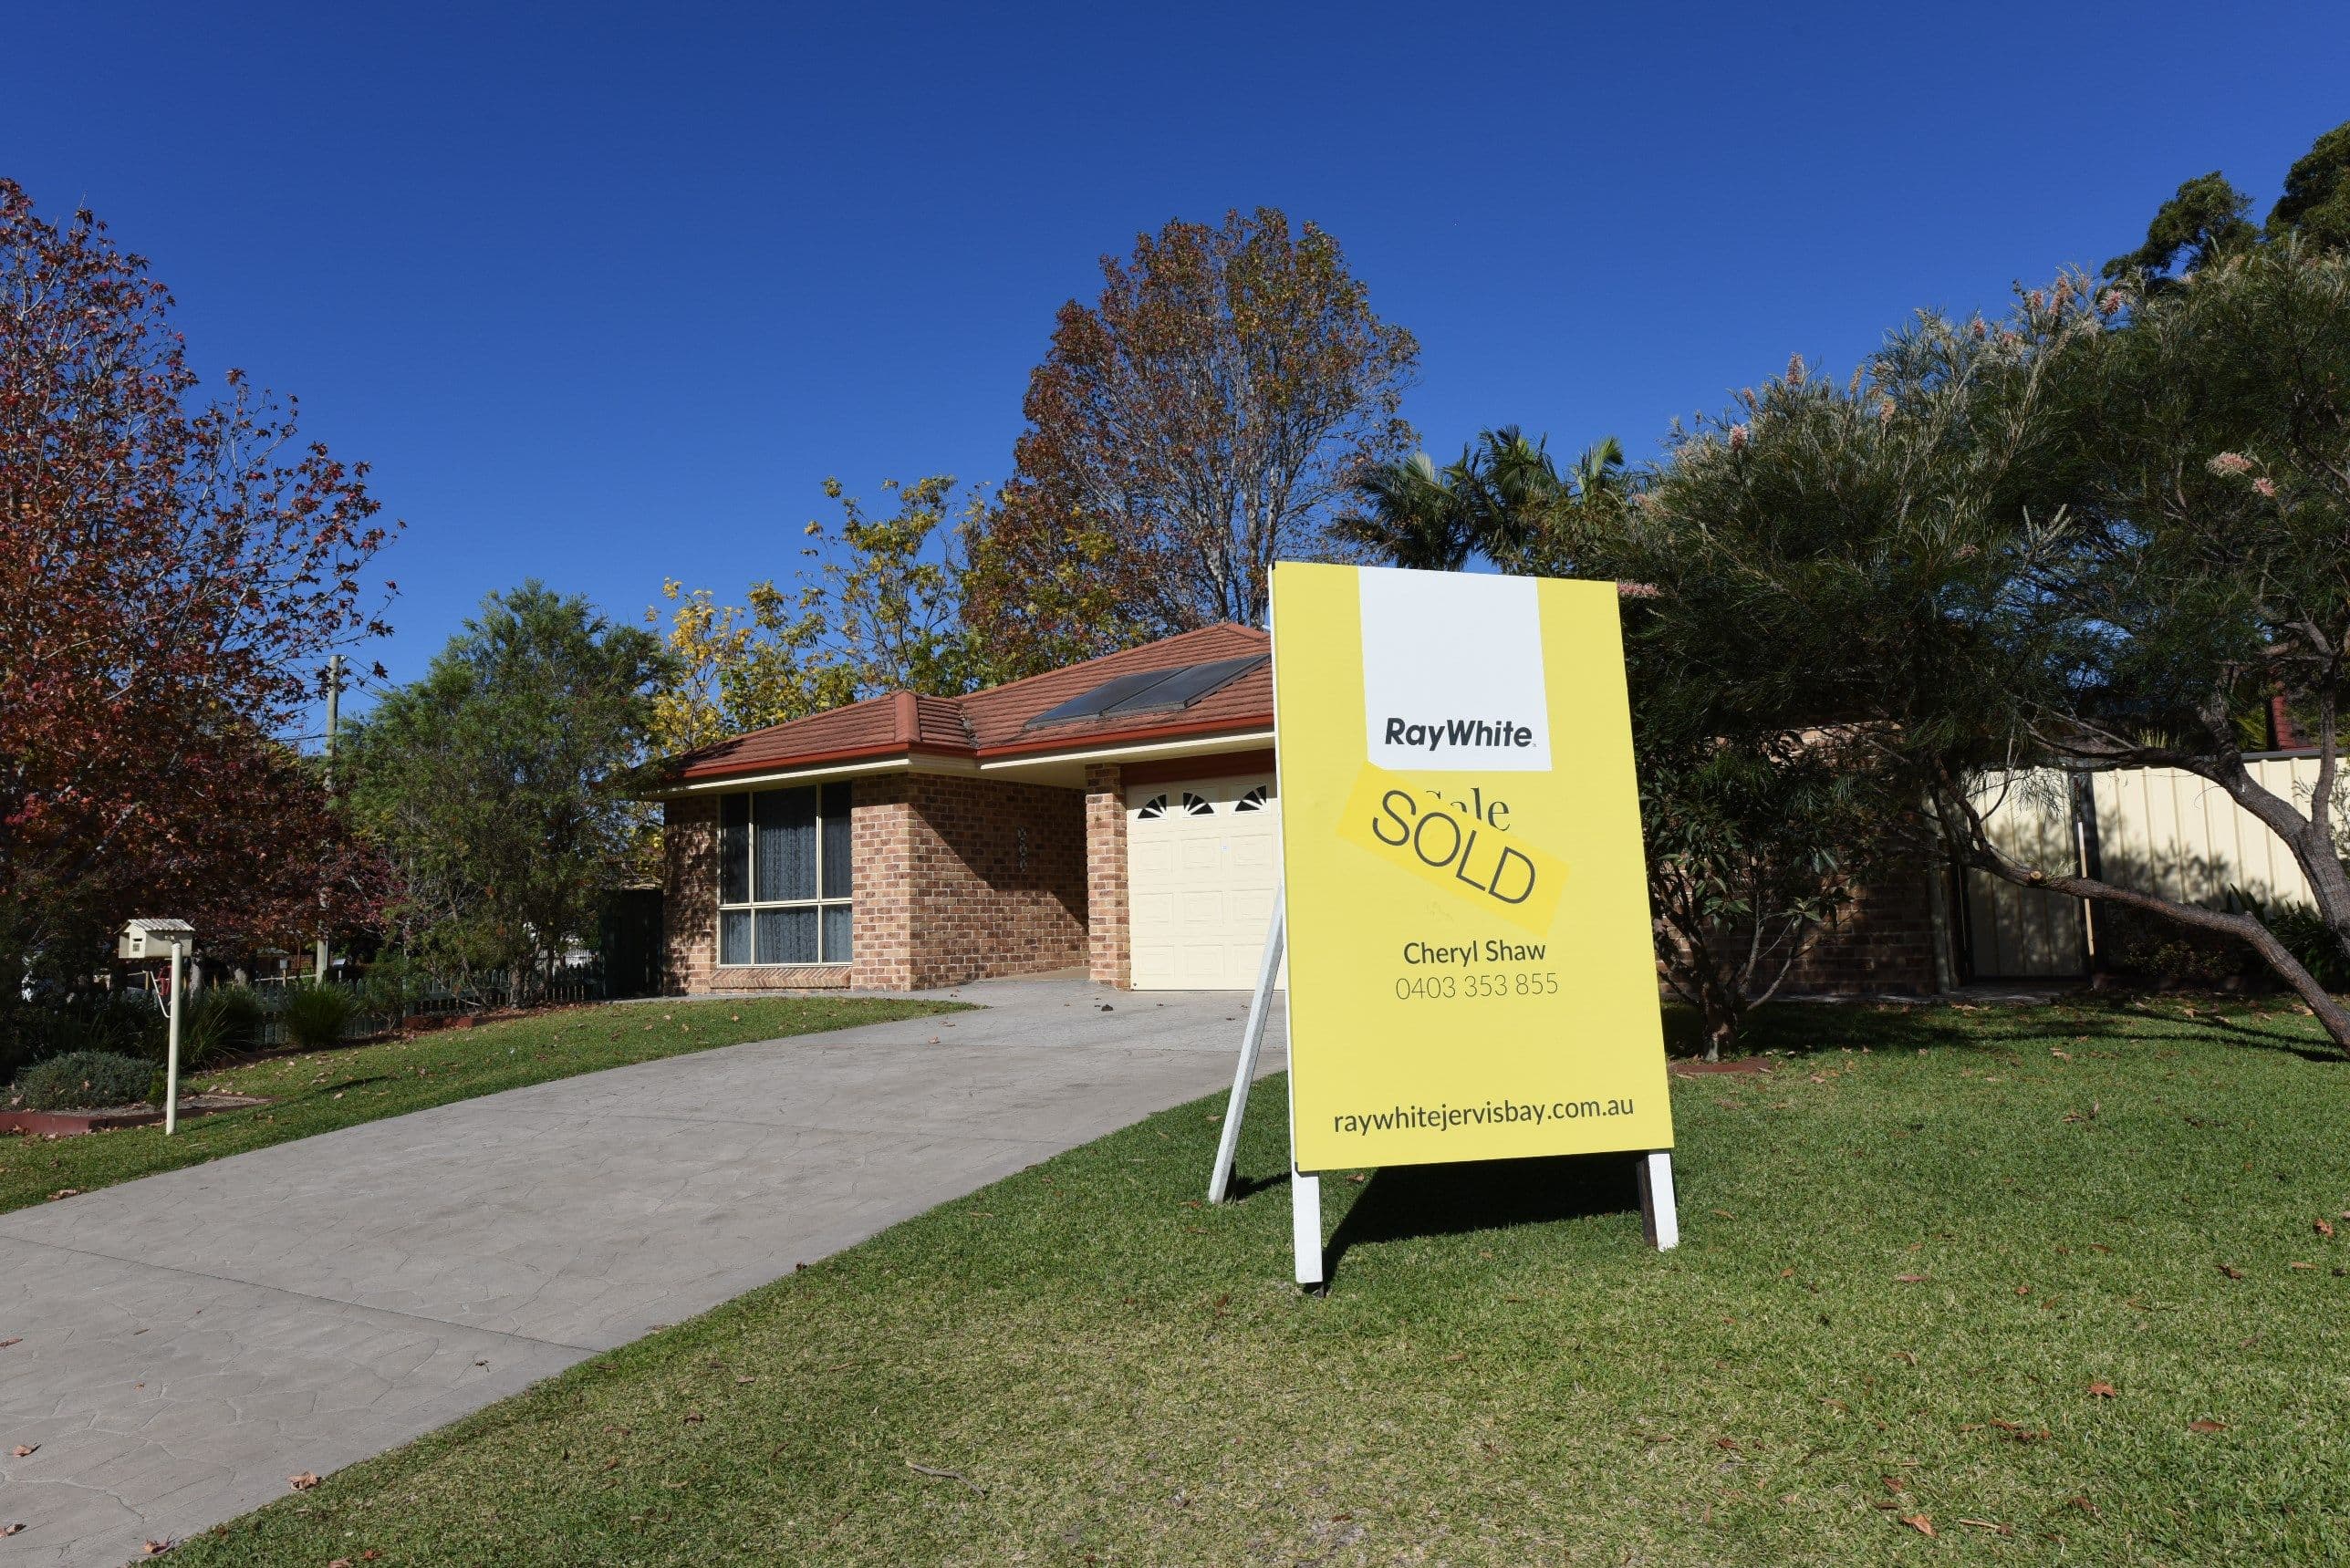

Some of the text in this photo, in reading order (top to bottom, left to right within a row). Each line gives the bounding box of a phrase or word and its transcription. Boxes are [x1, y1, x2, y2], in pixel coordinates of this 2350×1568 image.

[1425, 786, 1511, 832] le
[1372, 790, 1536, 904] SOLD
[1403, 939, 1546, 968] Cheryl Shaw
[1395, 971, 1558, 1001] 0403 353 855
[1334, 1097, 1635, 1137] raywhitejervisbay.com.au
